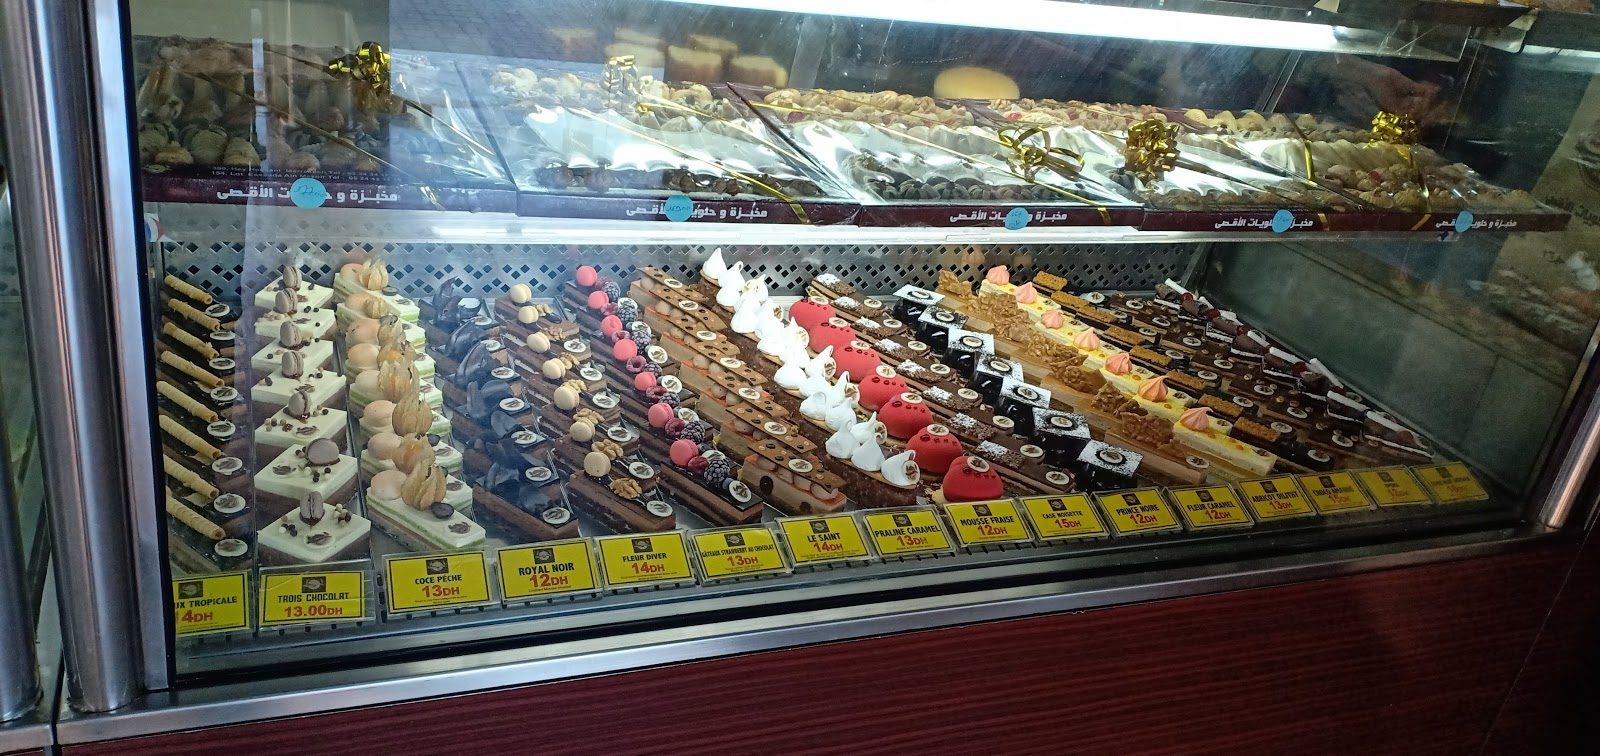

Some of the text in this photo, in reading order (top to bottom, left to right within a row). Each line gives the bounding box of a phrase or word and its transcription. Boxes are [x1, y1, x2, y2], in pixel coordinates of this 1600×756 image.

[216, 184, 274, 199] الأقصى
[336, 191, 346, 203] و
[349, 189, 398, 203] مخبزة
[626, 204, 665, 216] أقصى
[691, 205, 717, 219] حلوي
[950, 208, 987, 223] الأقصى
[1035, 211, 1068, 223] مخبزة
[1247, 217, 1273, 229] لويات
[1290, 217, 1314, 229] مخبز
[1471, 219, 1488, 229] حلوي
[1116, 504, 1160, 516] PRINCE NOIRE
[1187, 503, 1207, 512] FLEUR
[1129, 513, 1158, 524] 12DH
[1205, 509, 1233, 520] 12DH
[960, 515, 1015, 527] MOUSSE FRAISE
[1055, 518, 1082, 529] 15DH
[874, 525, 941, 538] PRALINE CARAMEL
[977, 525, 1008, 536] 12DH
[807, 532, 841, 543] LE SAINT
[896, 535, 929, 546] 13DH
[813, 542, 844, 553] 14DH
[622, 552, 668, 562] FLEUR DIVER
[727, 555, 759, 567] 13DH
[518, 562, 575, 576] ROYAL NOIR
[631, 562, 666, 574] 14DH
[529, 574, 569, 588] 12DH
[421, 584, 460, 598] 13DH
[189, 595, 238, 609] TROPICALE
[278, 592, 350, 604] TROIS CHOCOLAT
[284, 604, 343, 618] 13.00DH
